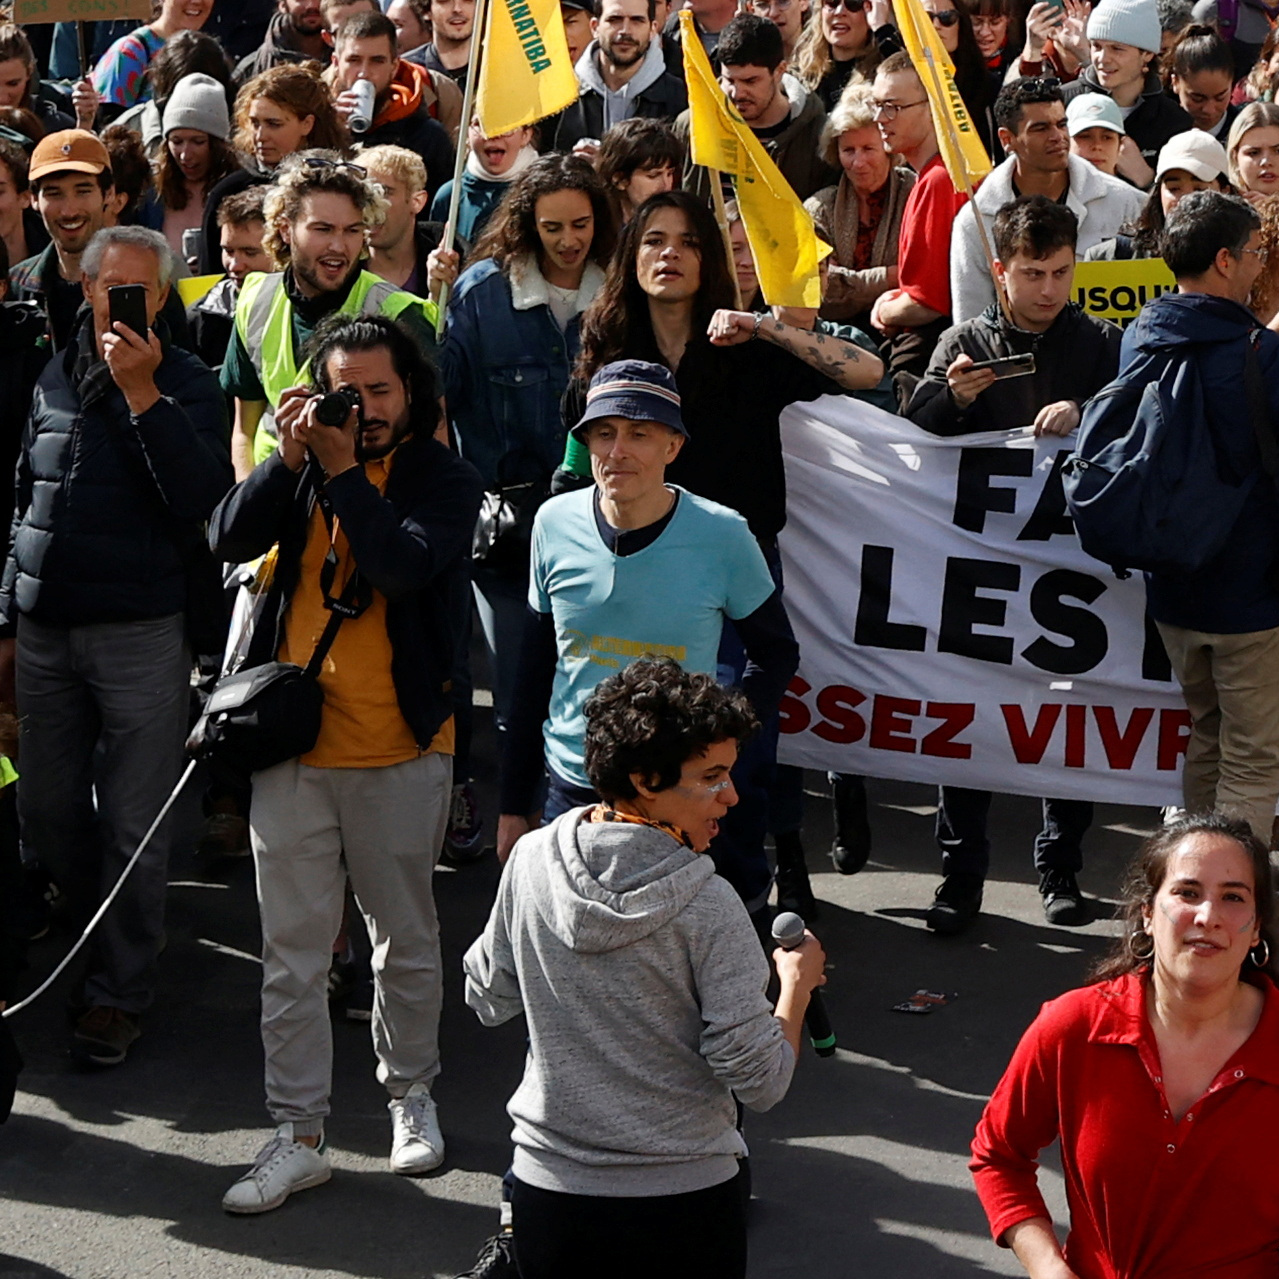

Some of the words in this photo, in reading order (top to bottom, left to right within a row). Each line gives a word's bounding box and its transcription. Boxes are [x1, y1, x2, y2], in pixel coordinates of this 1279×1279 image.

[67, 0, 118, 14] CONS
[333, 603, 357, 616] SONY
[854, 544, 1108, 675] LES
[1001, 701, 1188, 772] VIVR
